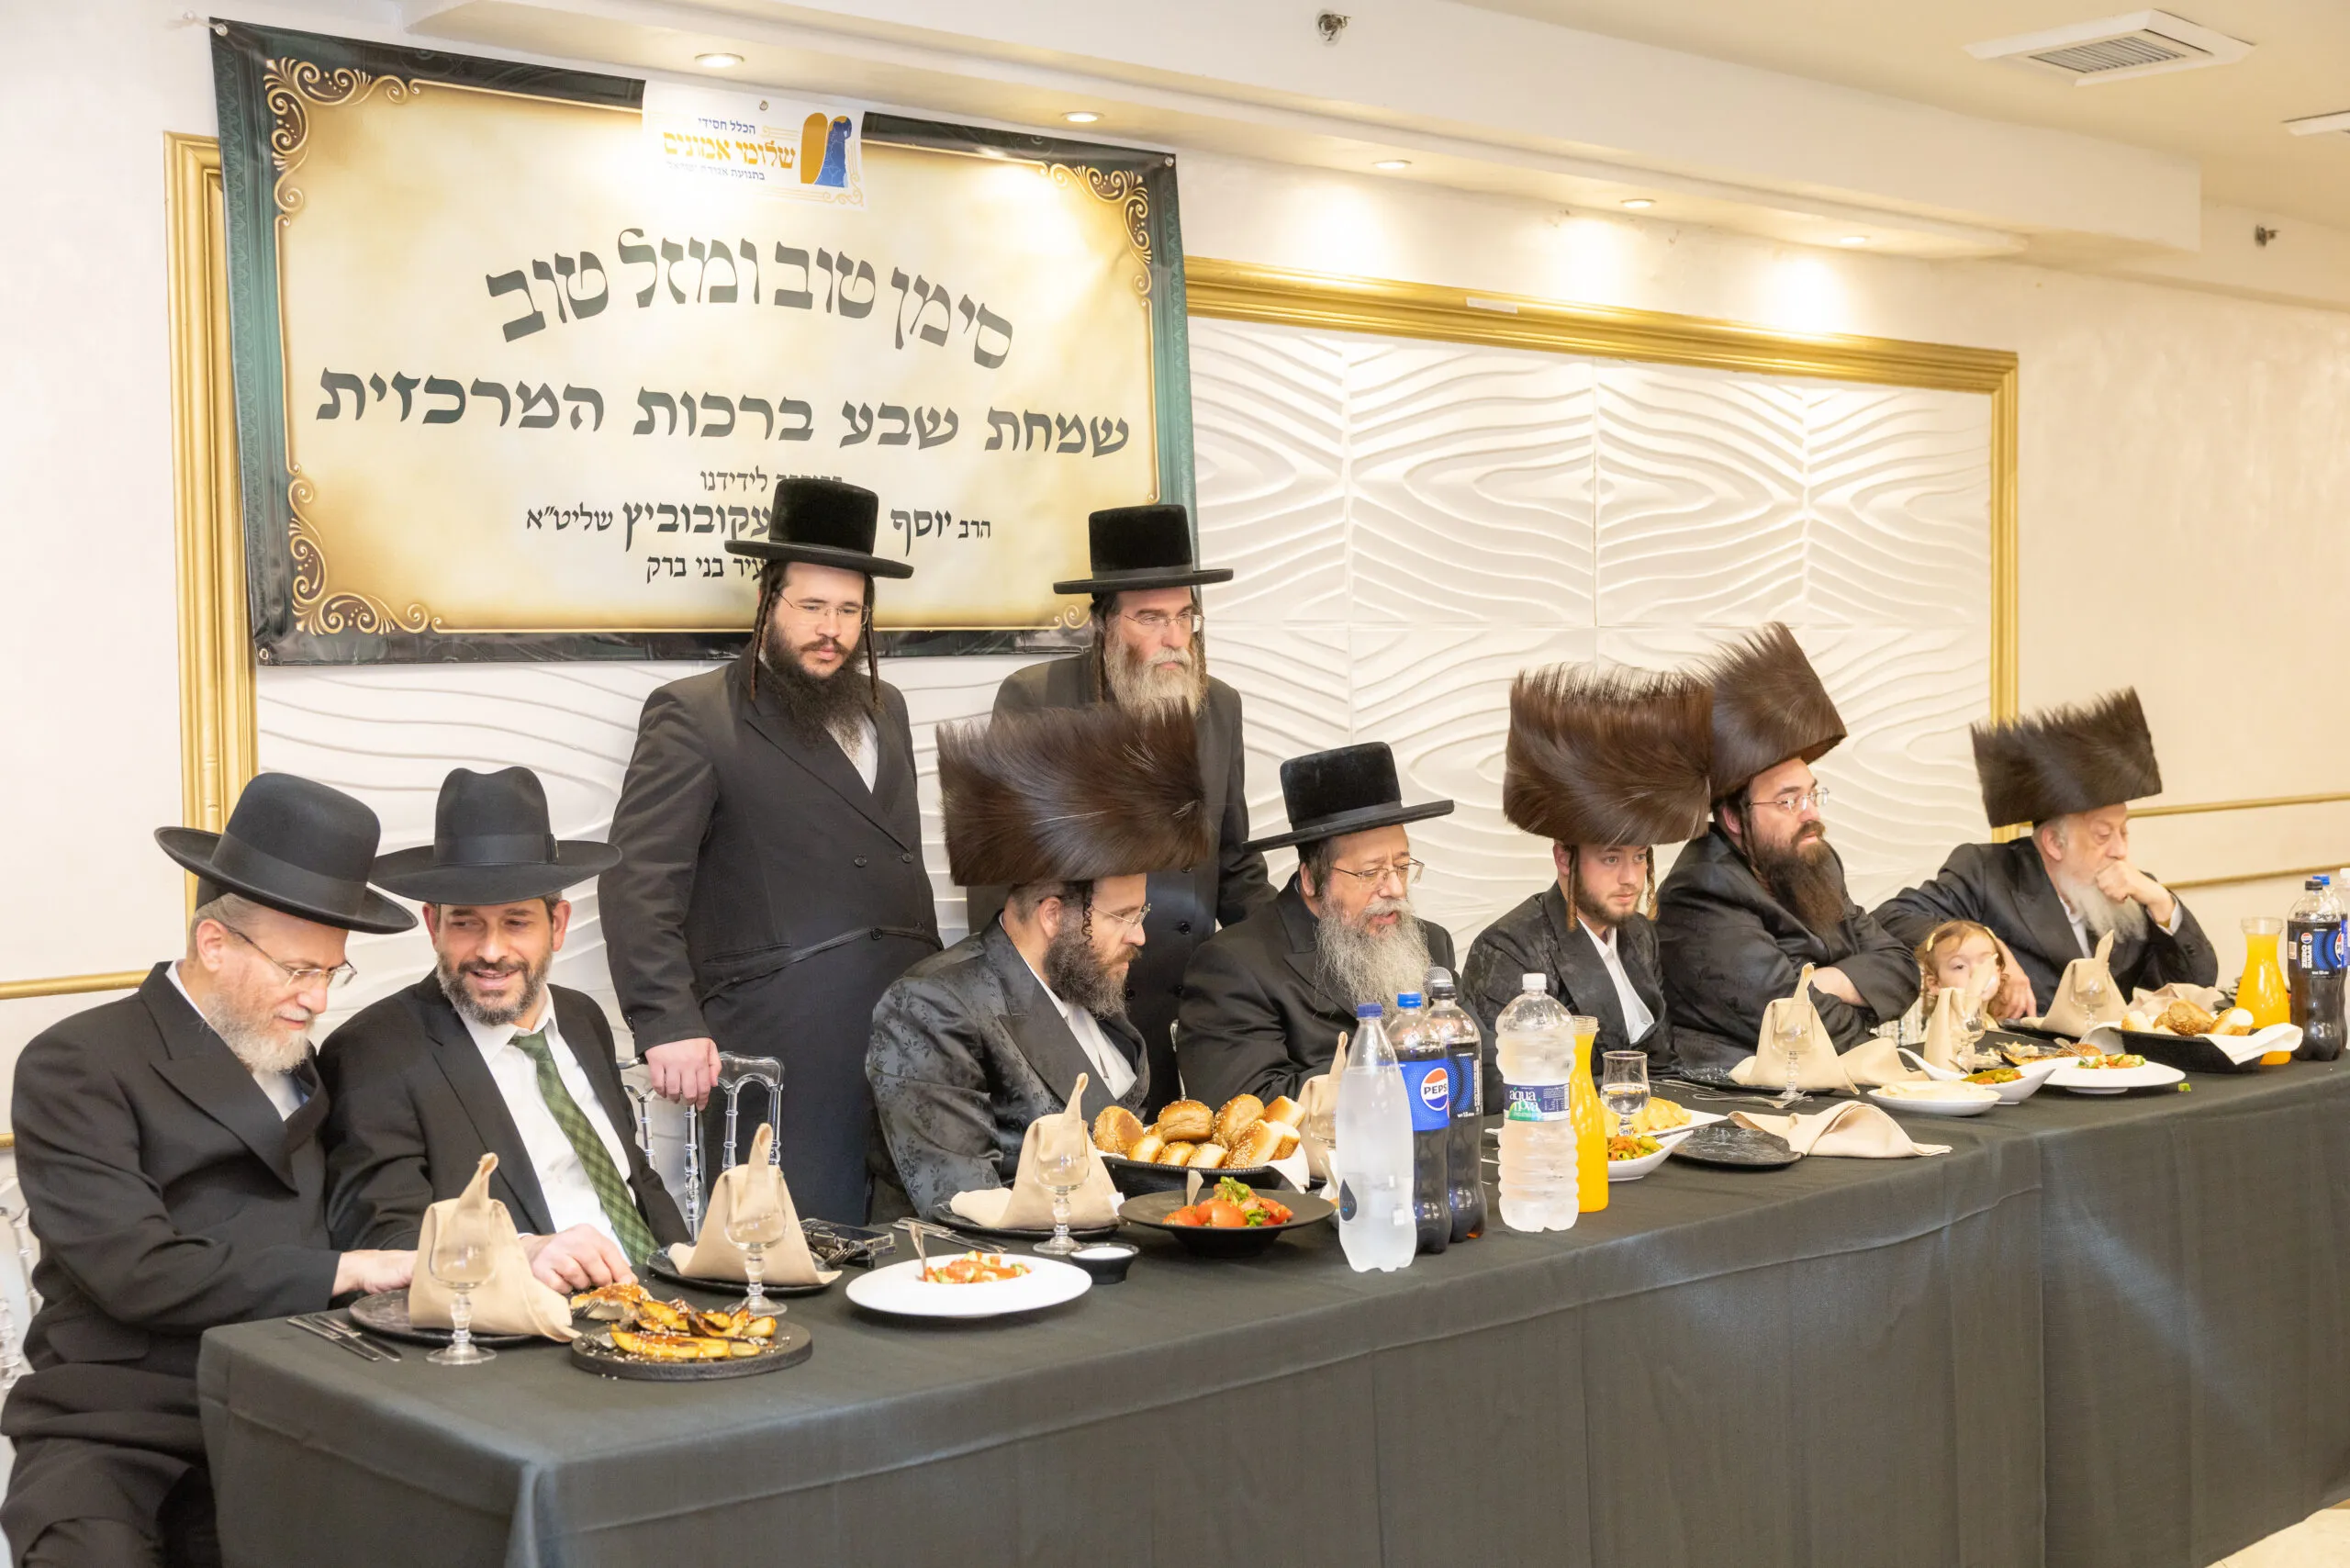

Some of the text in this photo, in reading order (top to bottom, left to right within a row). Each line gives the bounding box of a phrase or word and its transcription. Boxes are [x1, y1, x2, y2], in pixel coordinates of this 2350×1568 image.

[698, 118, 756, 136] הכלל חסידי
[662, 131, 797, 170] שלומי אמונים
[731, 168, 766, 181] בתנועת
[485, 228, 1013, 369] סימן טוב ומזל טוב
[316, 366, 1129, 458] שמחת שבע ברכות המרכזית
[700, 465, 768, 493] לידידנו
[622, 502, 772, 553] עקובוביץ
[890, 509, 952, 556] יוסף
[958, 519, 991, 540] הרב
[647, 555, 688, 585] ברק
[695, 556, 725, 578] בני
[1424, 1083, 1448, 1095] PEPS
[1509, 1090, 1537, 1103] aqua
